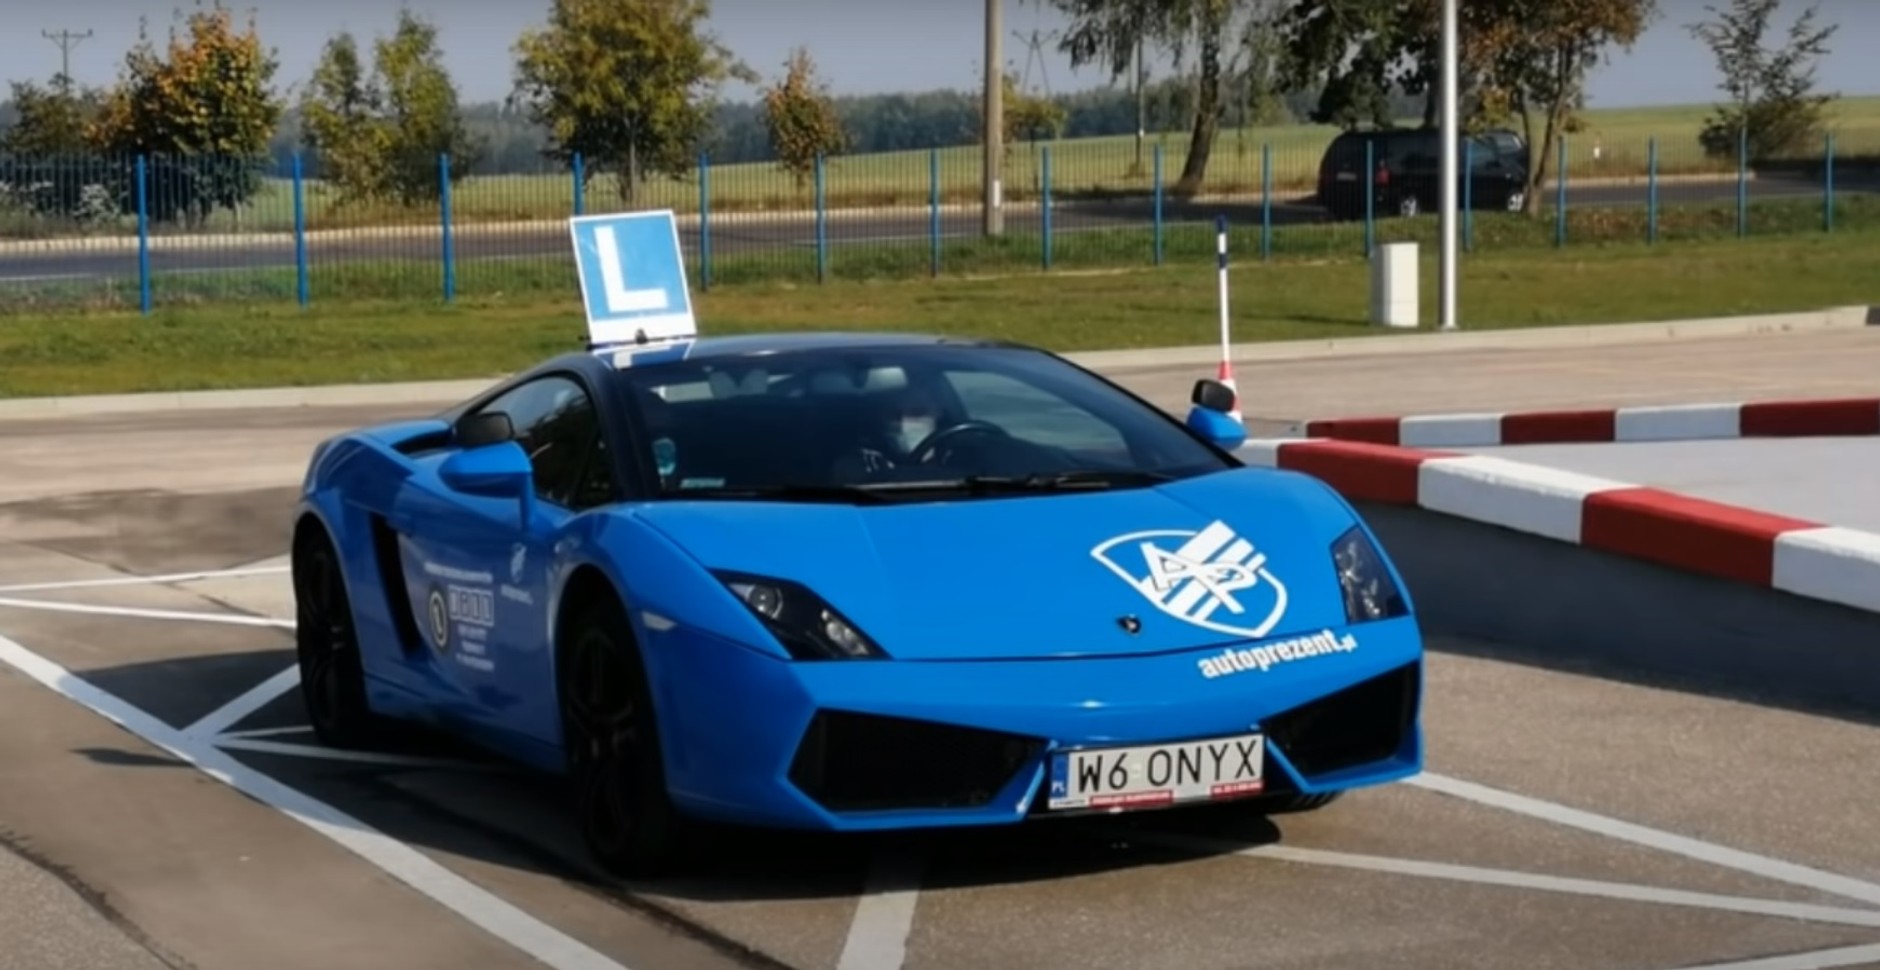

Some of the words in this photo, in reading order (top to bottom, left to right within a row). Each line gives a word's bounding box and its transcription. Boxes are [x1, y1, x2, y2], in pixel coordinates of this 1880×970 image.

[594, 225, 669, 313] L
[1078, 752, 1128, 794] W6
[1147, 739, 1257, 787] ONYX
